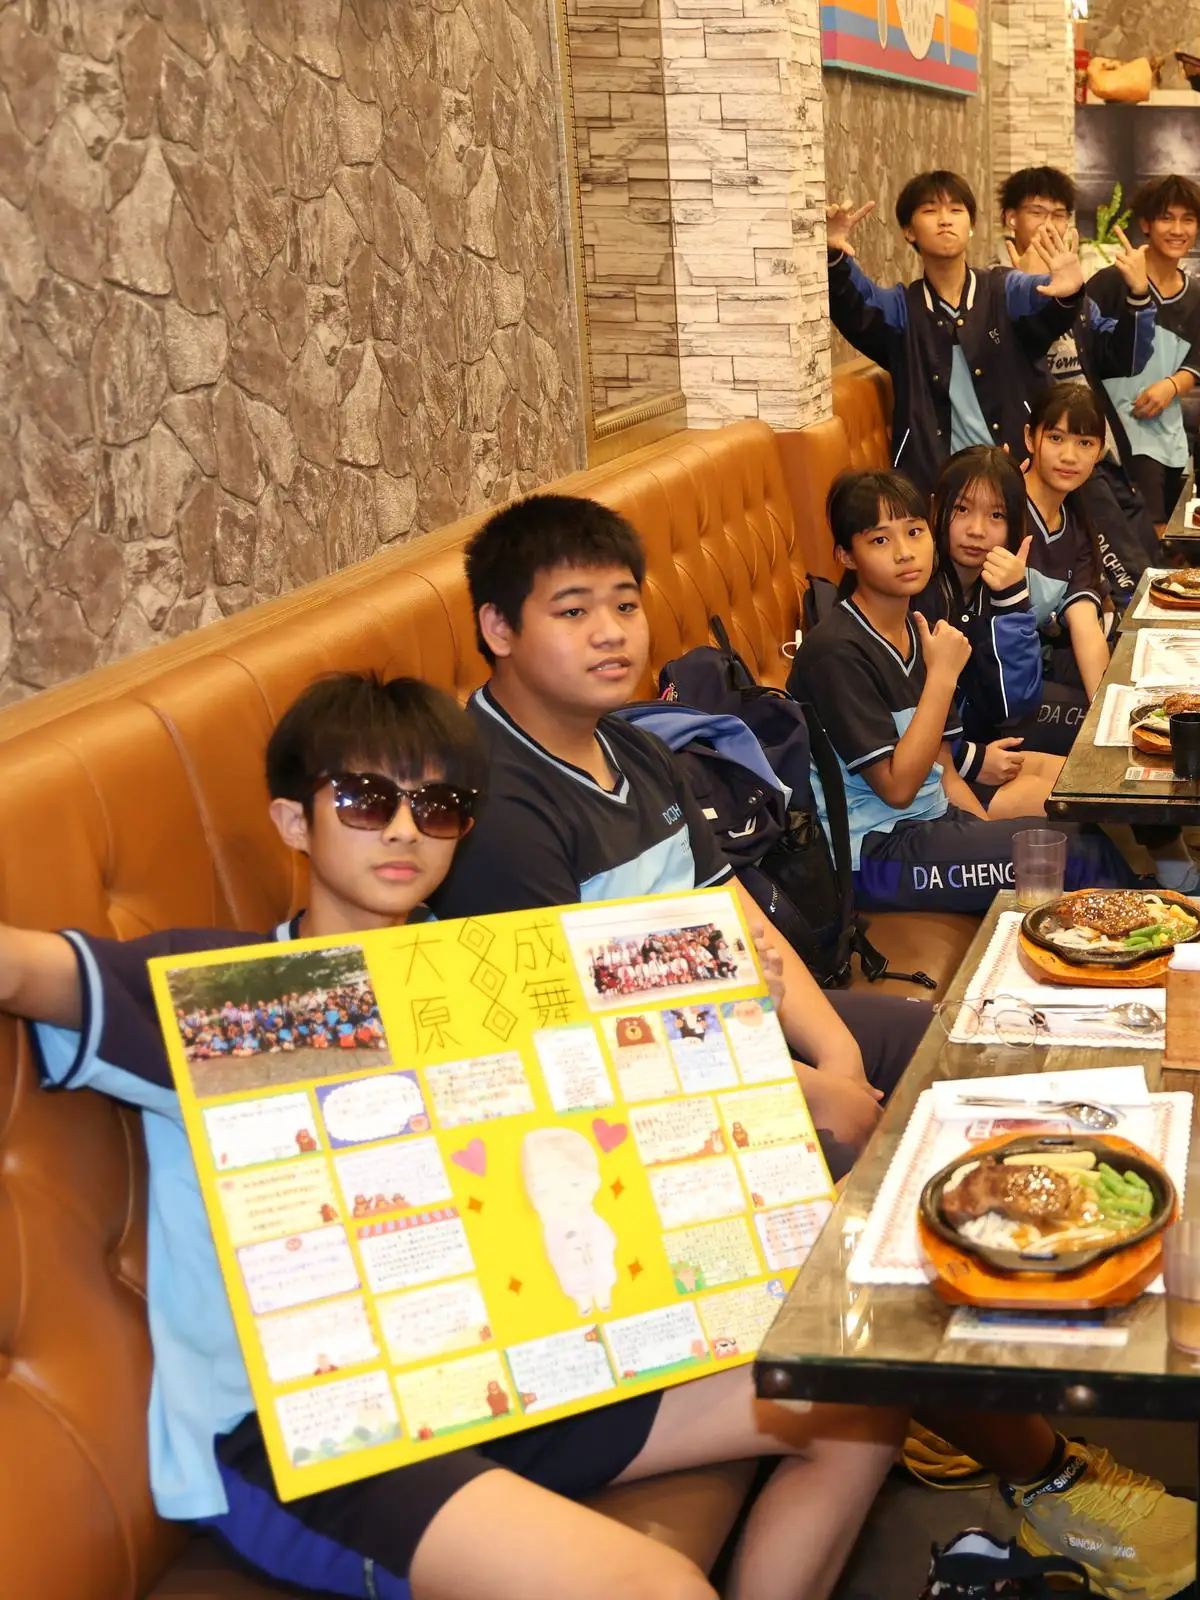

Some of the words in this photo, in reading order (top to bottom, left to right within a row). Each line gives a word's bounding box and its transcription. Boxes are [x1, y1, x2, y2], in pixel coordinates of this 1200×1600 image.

[1103, 553, 1135, 588] CHENG
[1037, 704, 1061, 724] DA
[912, 865, 944, 890] DA
[947, 862, 1017, 889] CHENG
